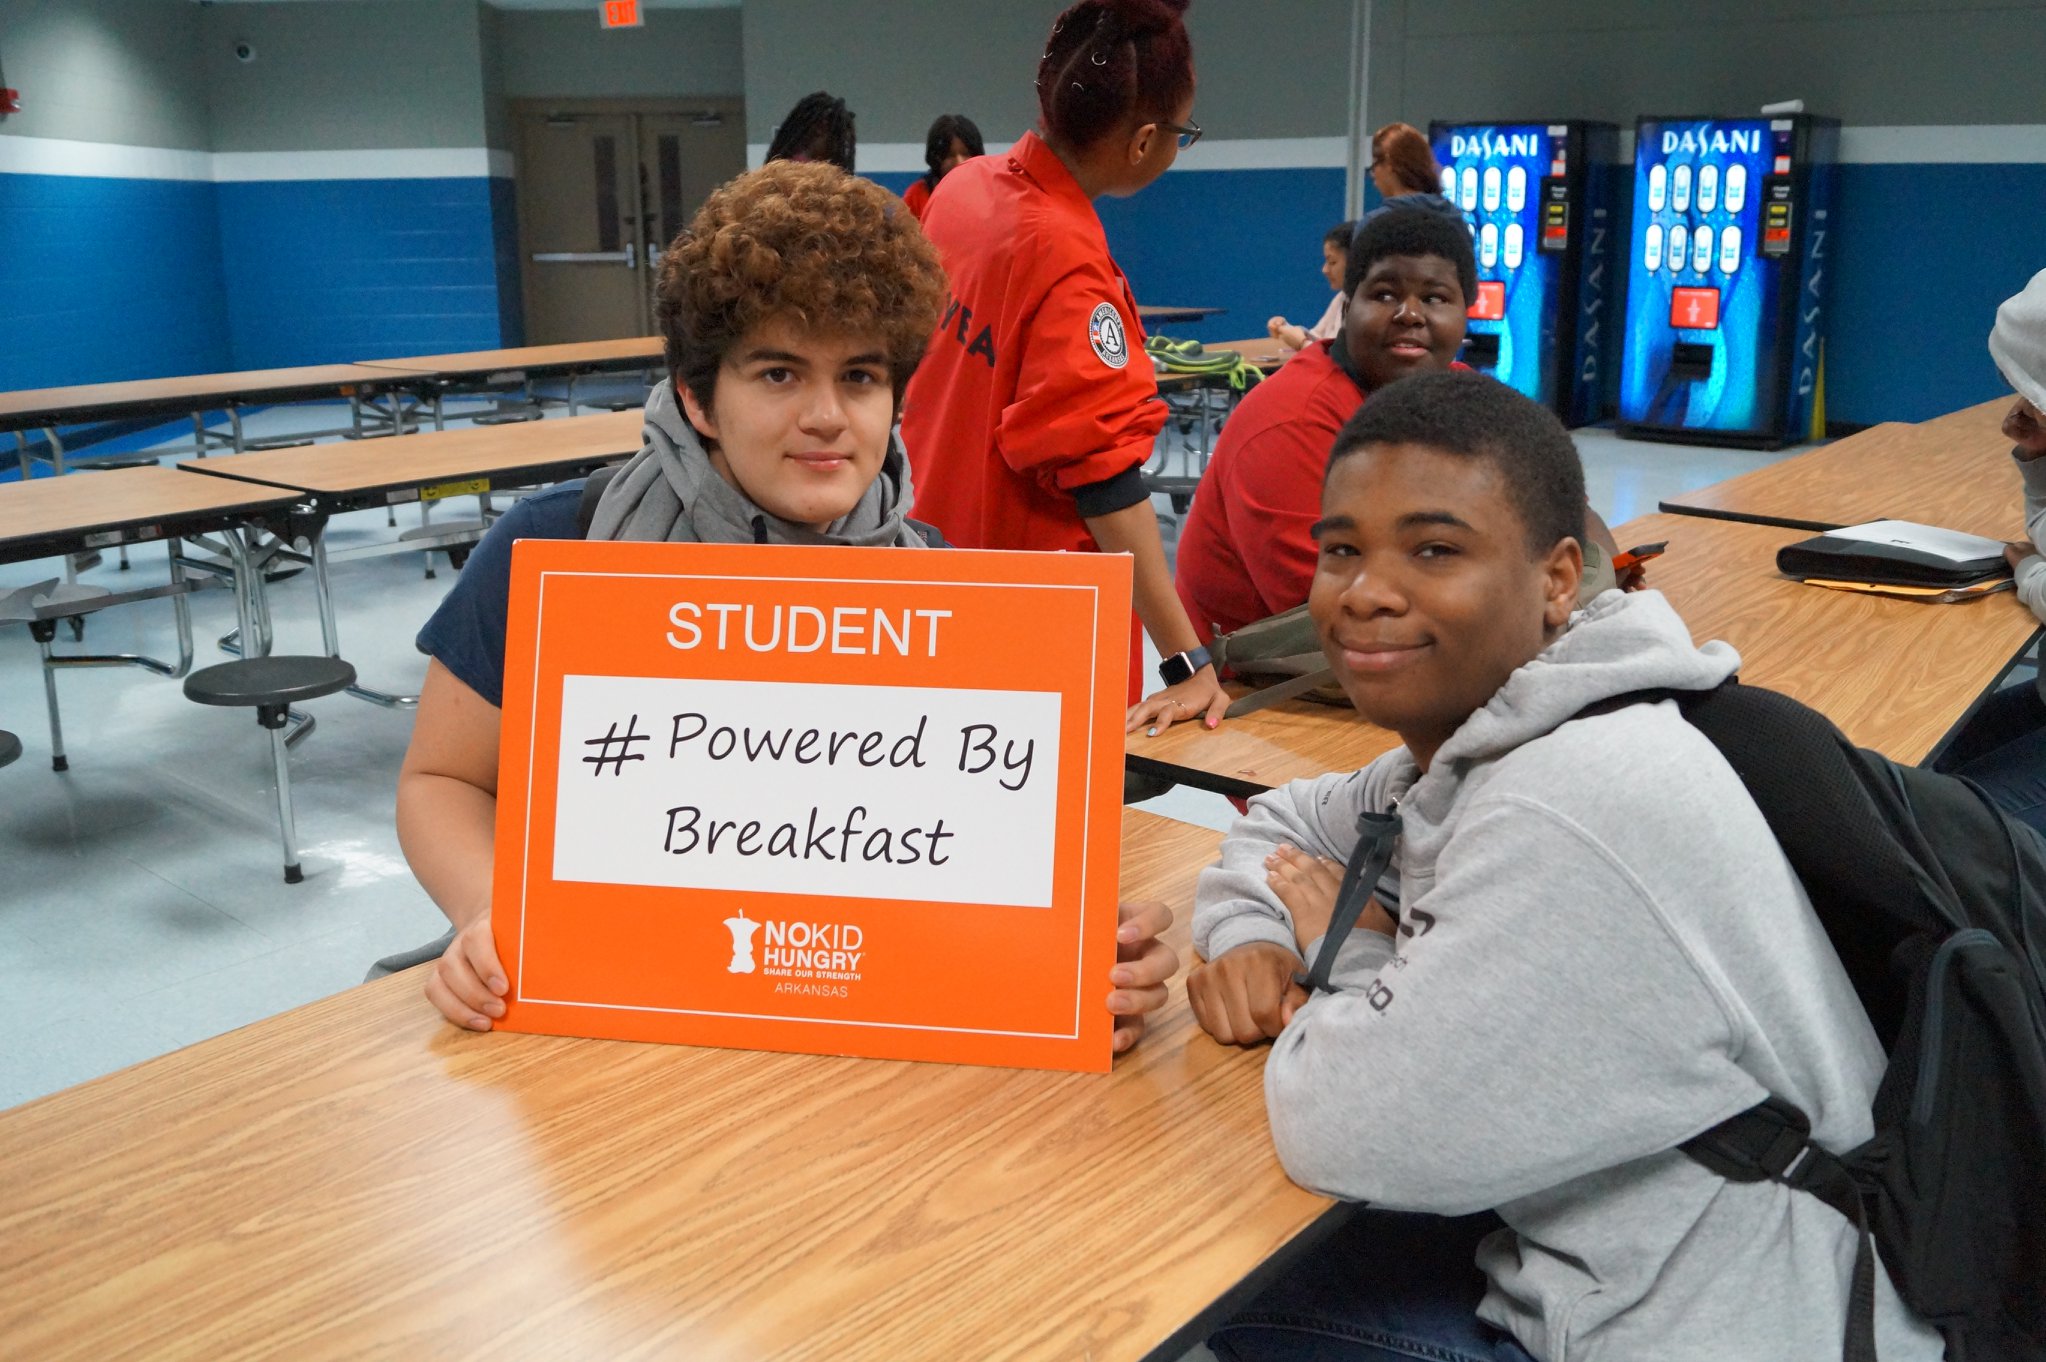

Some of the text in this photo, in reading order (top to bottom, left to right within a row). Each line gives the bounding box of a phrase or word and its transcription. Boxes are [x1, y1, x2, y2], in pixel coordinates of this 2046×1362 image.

[1451, 127, 1538, 160] DASANI
[1662, 122, 1760, 158] DASANI
[1106, 321, 1120, 346] A
[667, 602, 952, 656] STUDENT
[959, 724, 1034, 791] By
[664, 806, 954, 866] Breakfast
[763, 967, 862, 981] SHARE OUR STRENGTH
[764, 947, 862, 971] HUNGRY
[775, 982, 848, 998] ARKANSAS
